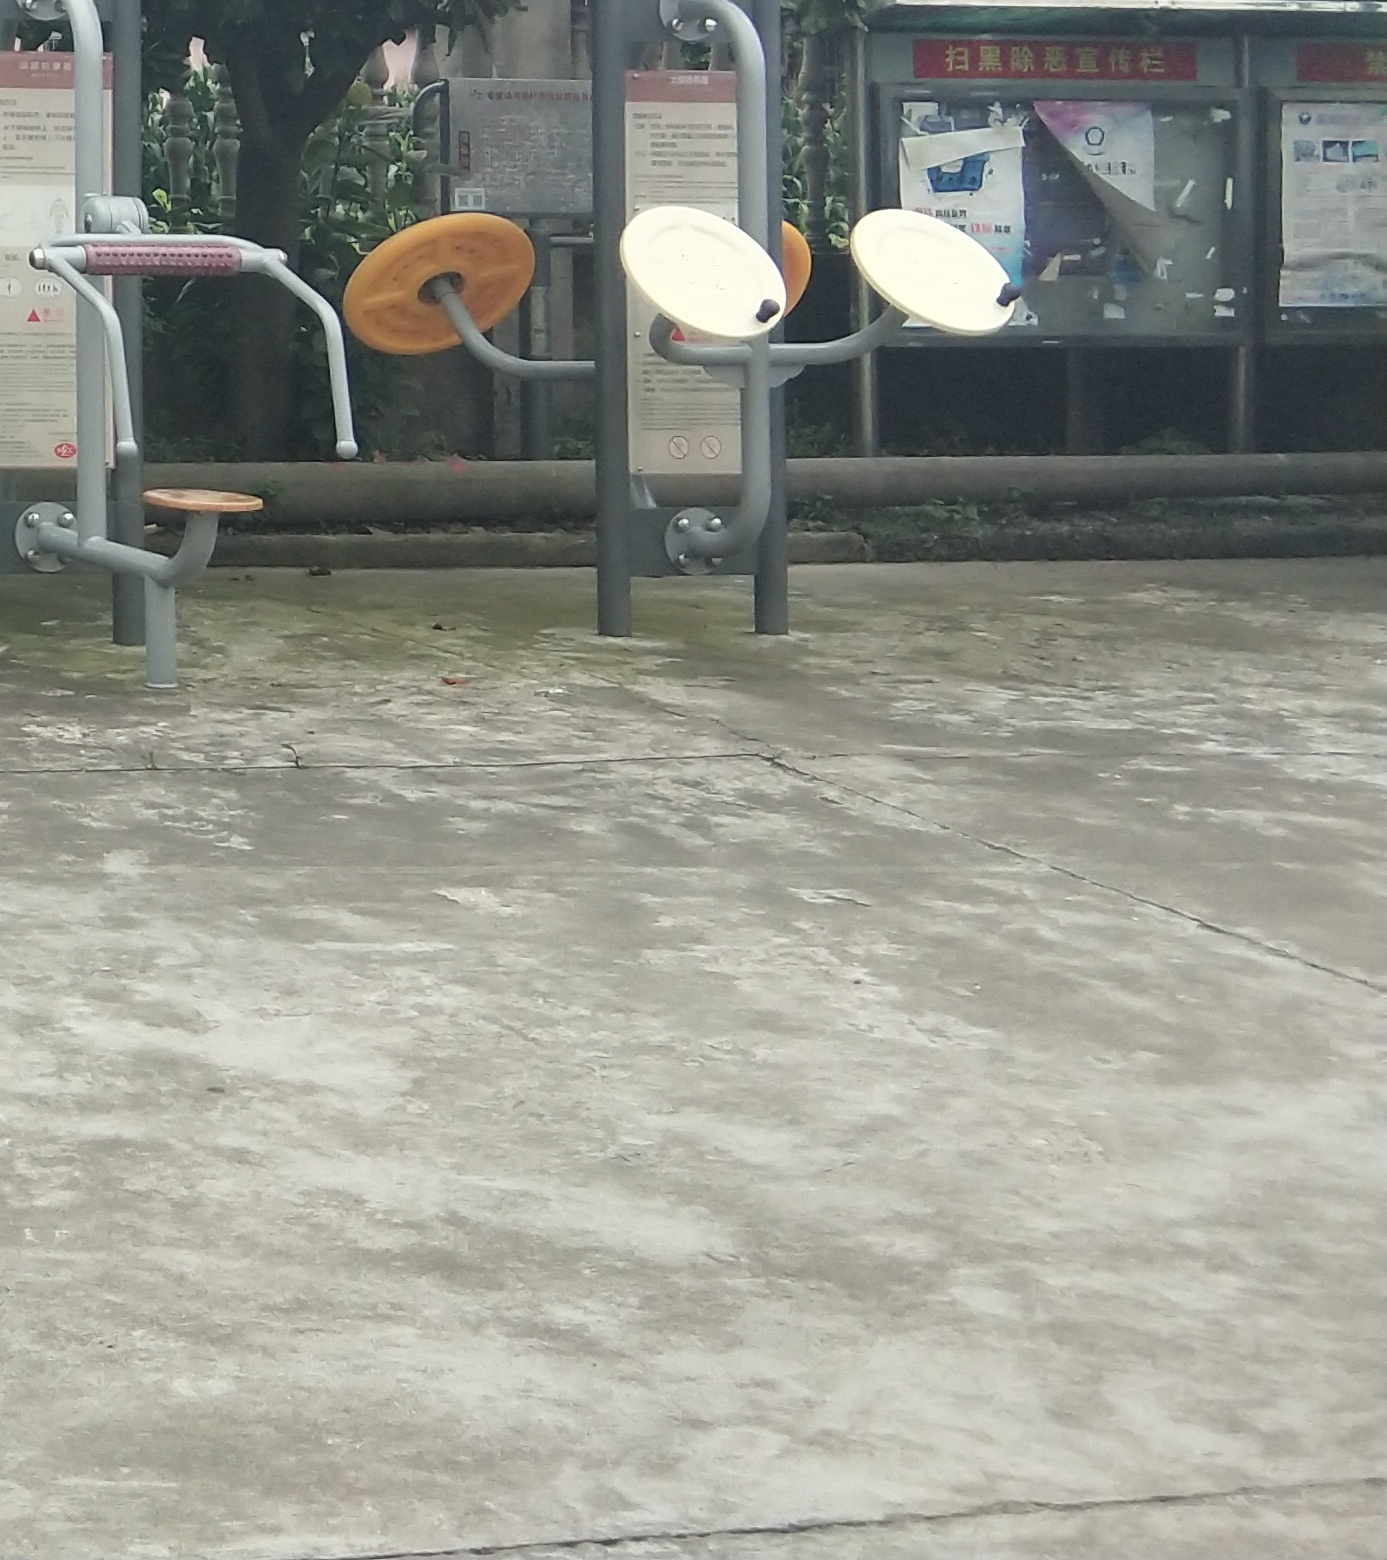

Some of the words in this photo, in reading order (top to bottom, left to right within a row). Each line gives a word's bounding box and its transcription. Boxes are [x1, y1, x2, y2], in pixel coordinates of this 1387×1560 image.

[945, 44, 1166, 74] 扫黑除恶宣传栏
